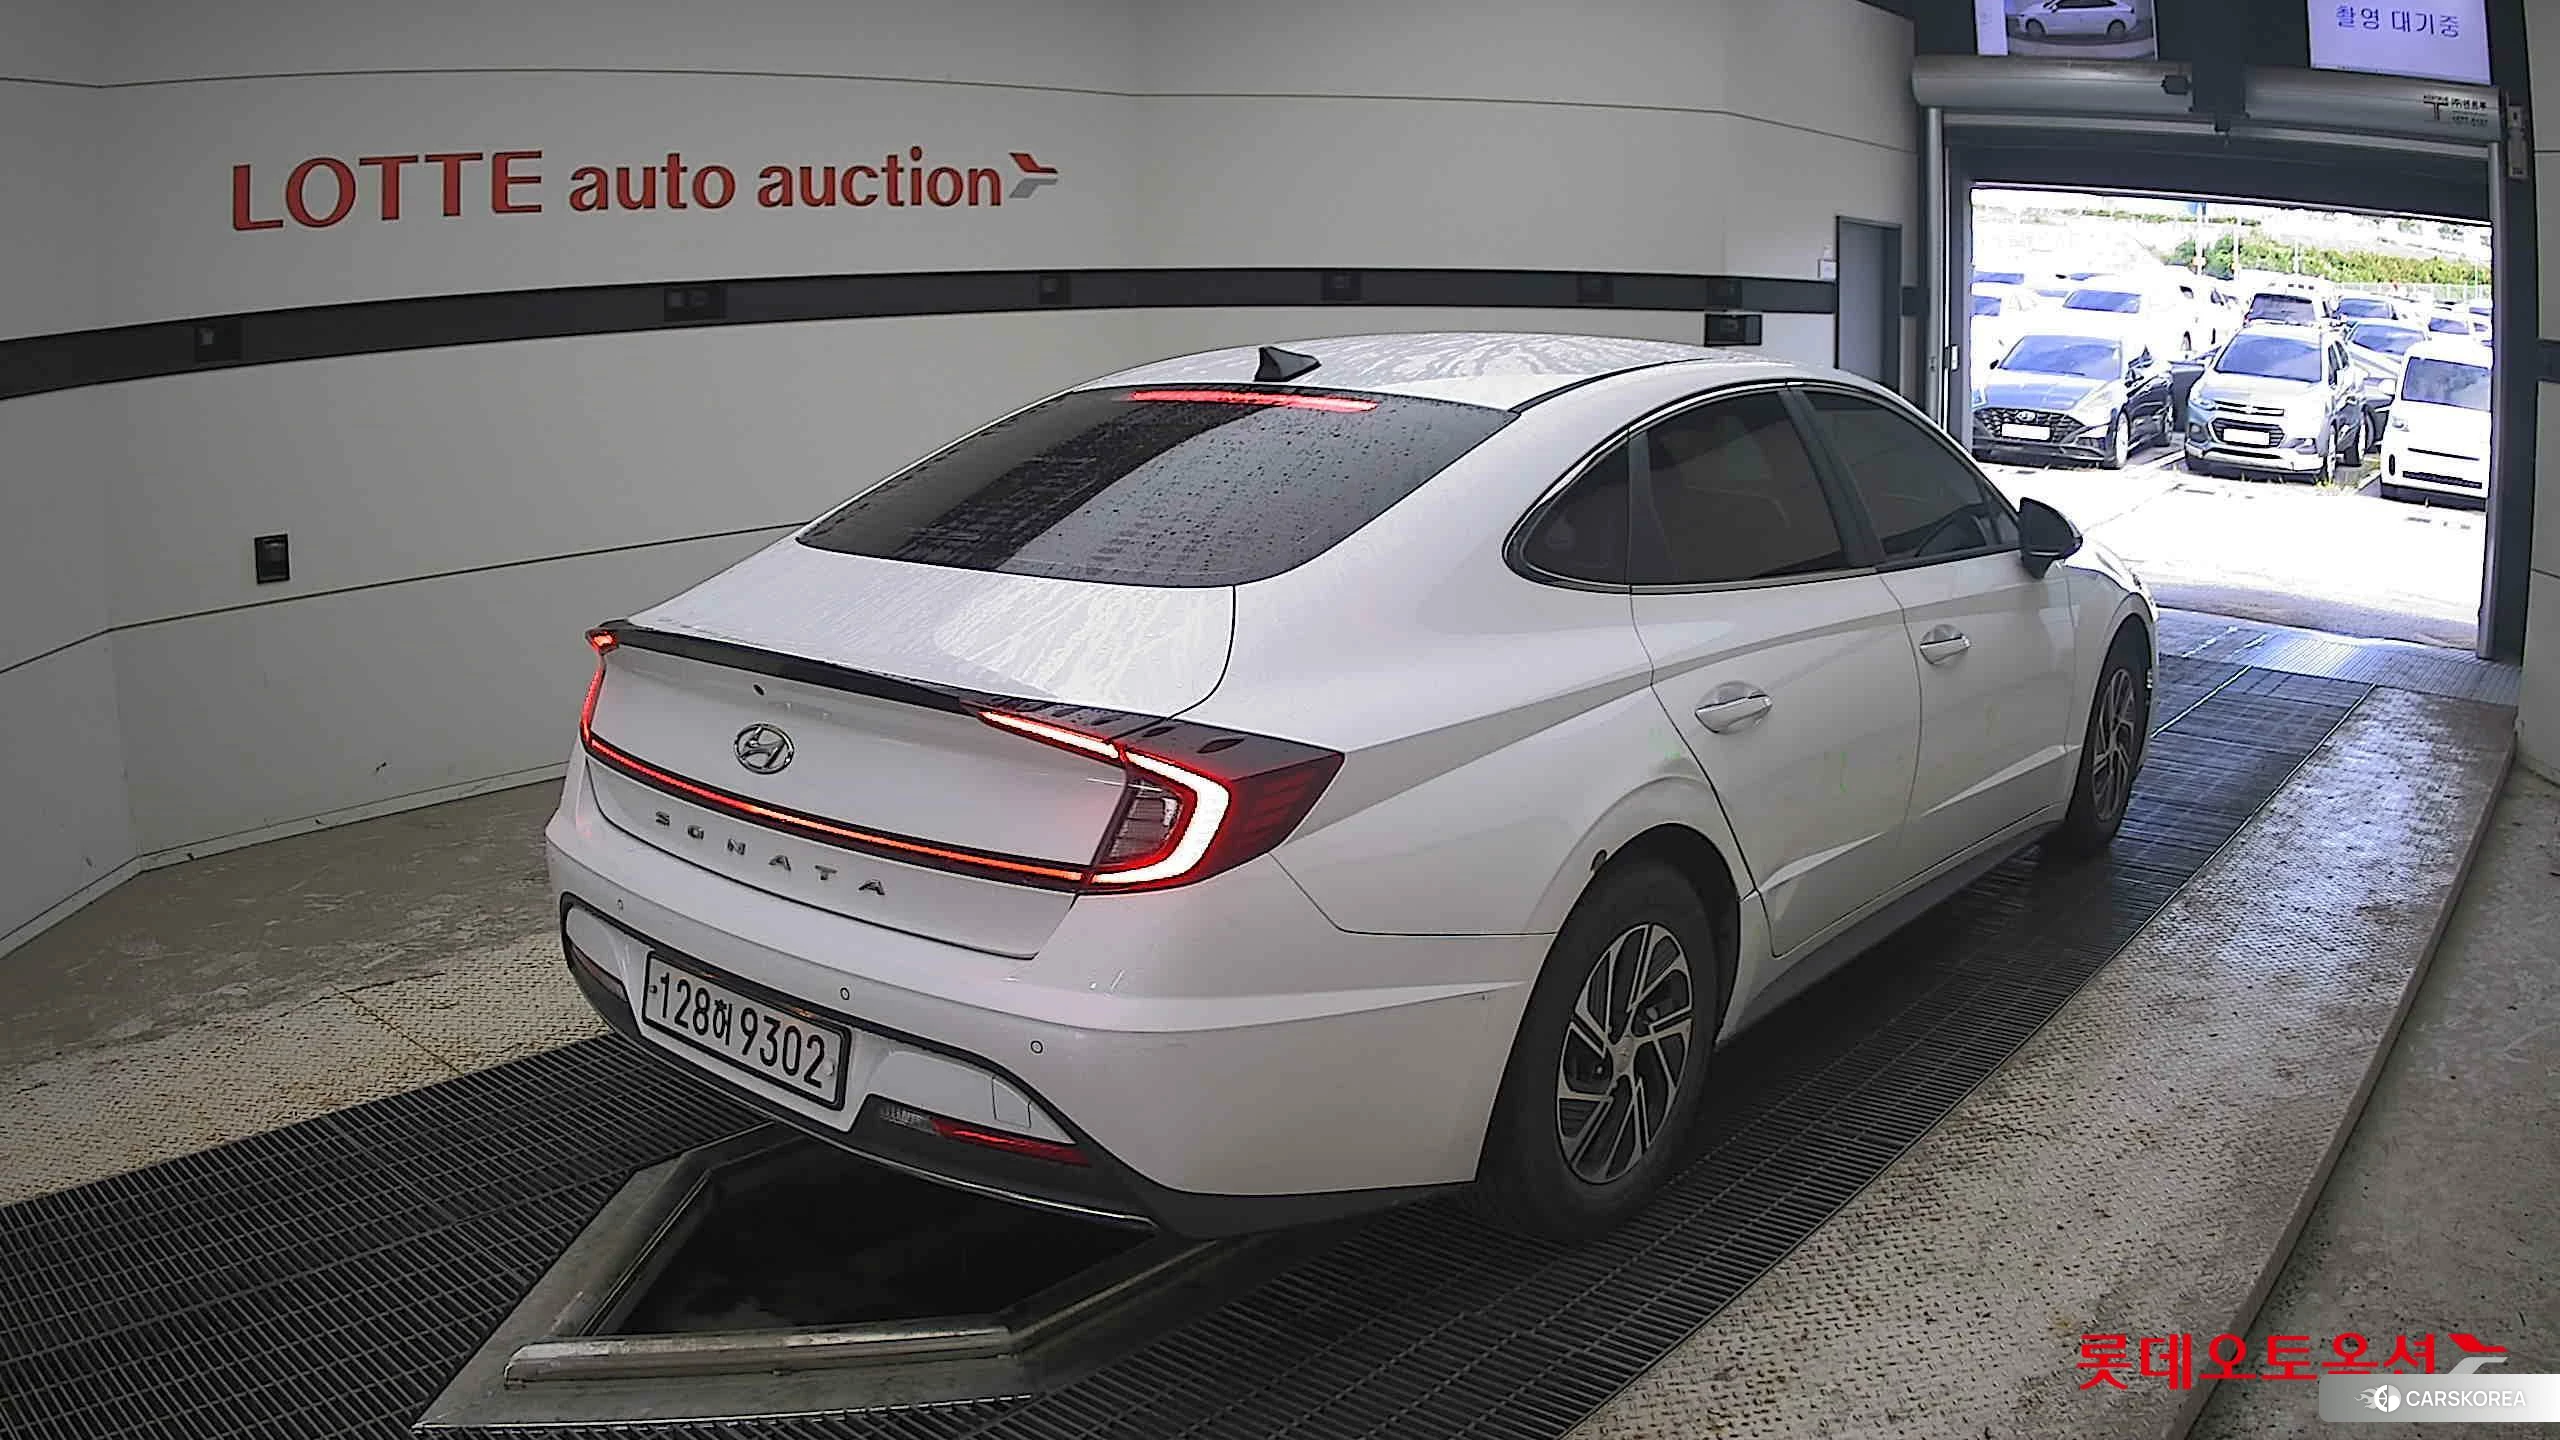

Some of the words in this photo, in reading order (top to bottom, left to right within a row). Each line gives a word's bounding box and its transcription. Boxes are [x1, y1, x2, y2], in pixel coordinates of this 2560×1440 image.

[2337, 5, 2380, 30] 촬영
[2391, 10, 2459, 38] 대기중
[233, 150, 542, 231] LOTTE
[569, 152, 736, 212] auto
[757, 145, 1002, 208] auction
[655, 811, 886, 896] SONATA
